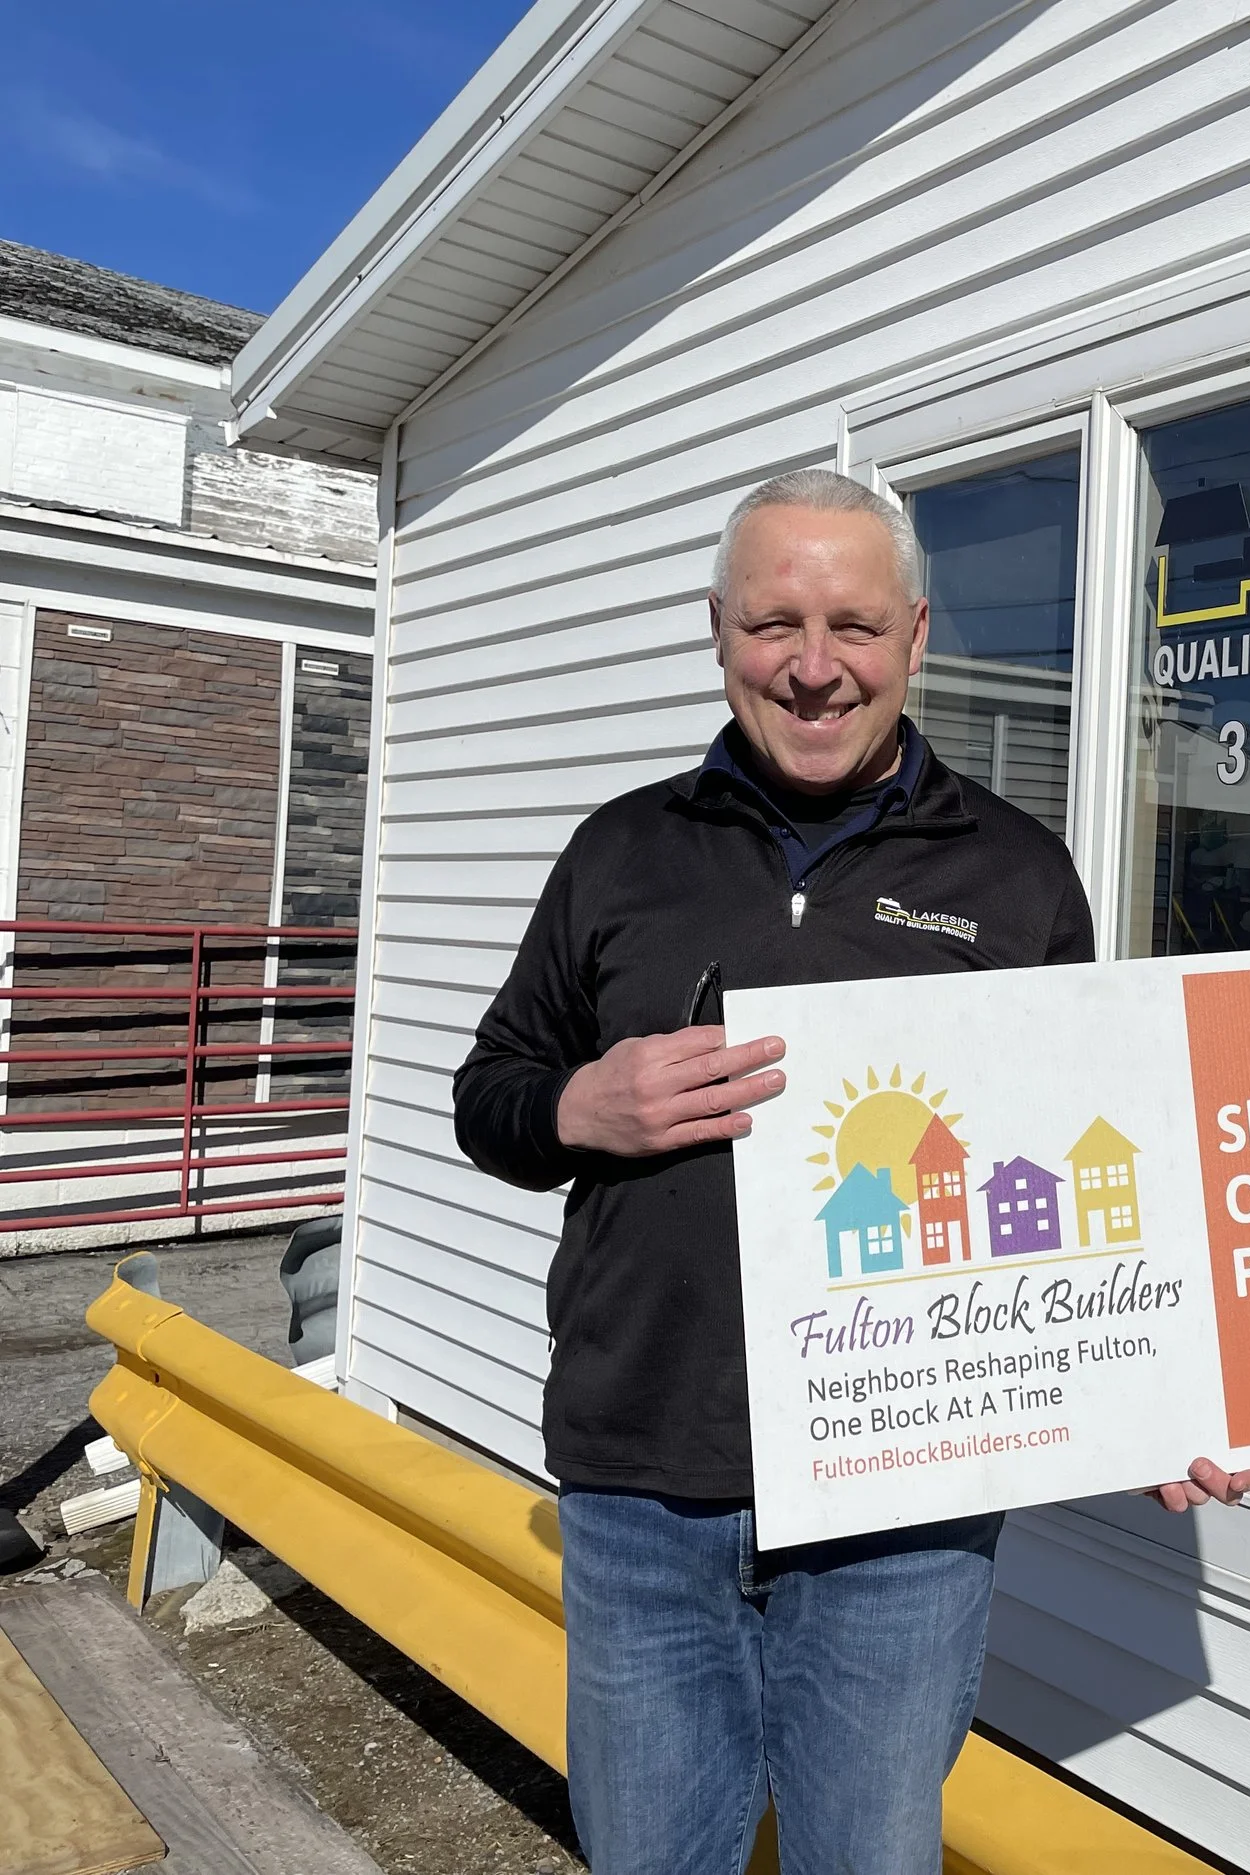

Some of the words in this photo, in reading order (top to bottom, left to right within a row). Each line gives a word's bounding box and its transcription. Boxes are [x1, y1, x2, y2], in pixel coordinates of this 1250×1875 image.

[874, 912, 906, 926] QUALITY
[906, 921, 940, 933] BUILDING
[941, 925, 976, 943] PRODUCTS
[912, 909, 979, 933] LAKESIDE
[790, 1295, 915, 1358] Fulton
[926, 1274, 1036, 1340] Block
[1040, 1259, 1183, 1325] Builders
[807, 1365, 937, 1403] Neighbors
[944, 1345, 1071, 1385] Reshaping
[1077, 1333, 1158, 1365] Fulton,
[809, 1415, 862, 1441] One
[870, 1402, 941, 1434] Block
[946, 1393, 973, 1421] At
[979, 1390, 998, 1416] A
[1002, 1384, 1064, 1413] Time
[812, 1422, 1071, 1482] FultonBlockBuilders.com
